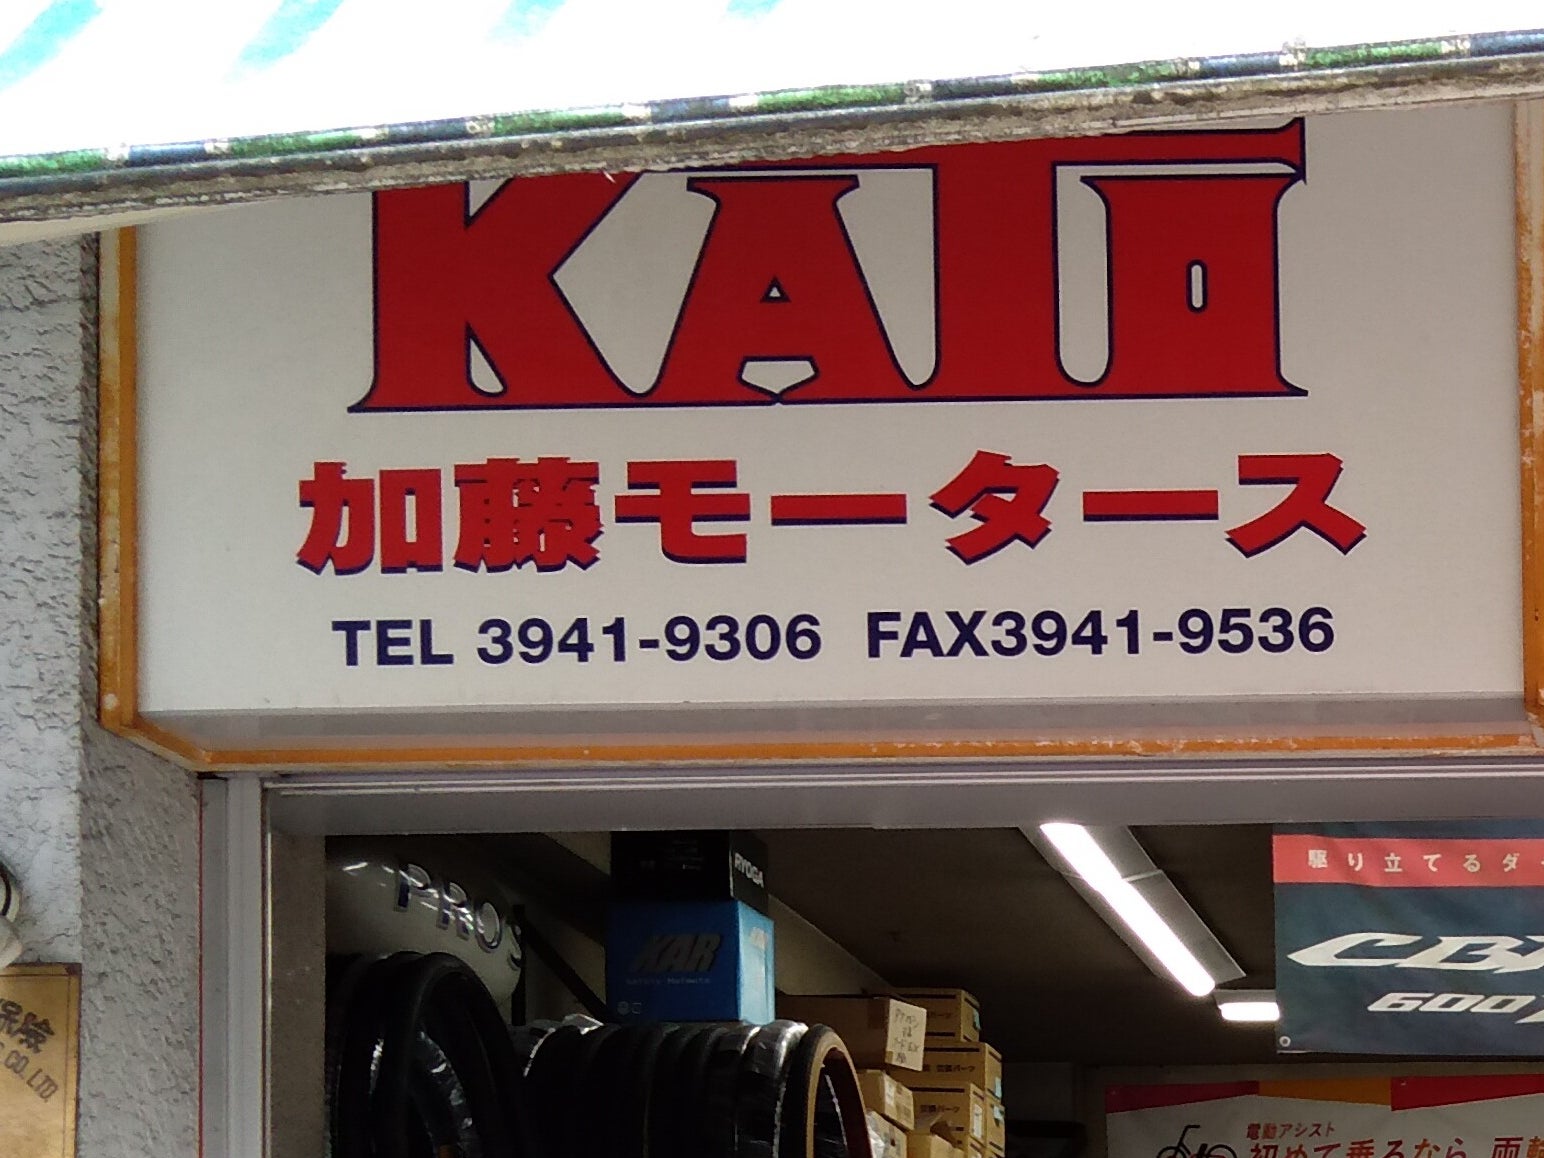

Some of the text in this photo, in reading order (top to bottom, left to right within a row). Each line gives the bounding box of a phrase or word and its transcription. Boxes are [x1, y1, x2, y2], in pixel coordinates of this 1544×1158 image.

[296, 450, 1367, 576] 加藤モータース
[332, 606, 1337, 668] TEL 3941-9306 FAX3941-9536
[1246, 1122, 1336, 1141] 電動アシスト
